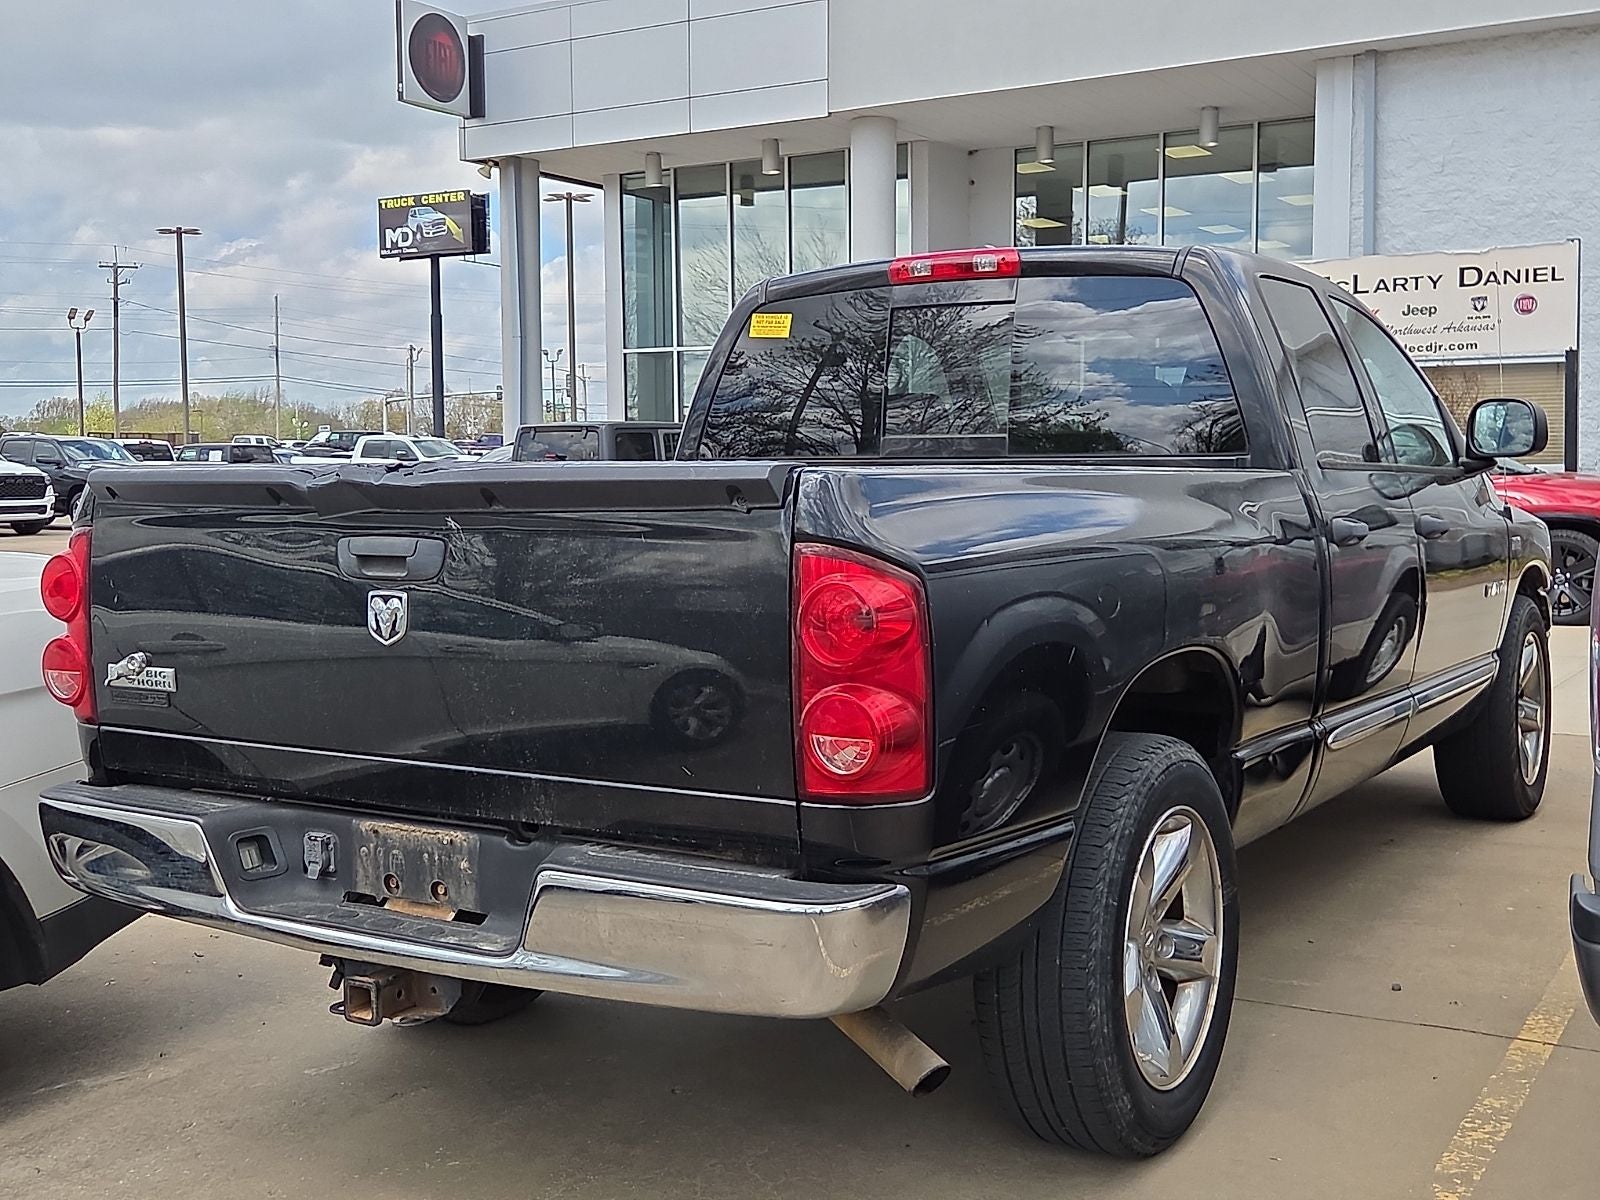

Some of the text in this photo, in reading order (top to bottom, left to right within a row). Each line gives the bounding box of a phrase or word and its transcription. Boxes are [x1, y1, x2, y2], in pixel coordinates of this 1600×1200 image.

[380, 191, 466, 209] TRUCK CENTER
[385, 227, 413, 249] MD
[1324, 266, 1565, 295] LARTY DANIEL
[1402, 304, 1438, 317] Jeep
[1440, 321, 1496, 334] Arkansas
[145, 669, 167, 679] BIG
[137, 679, 172, 689] HORN
